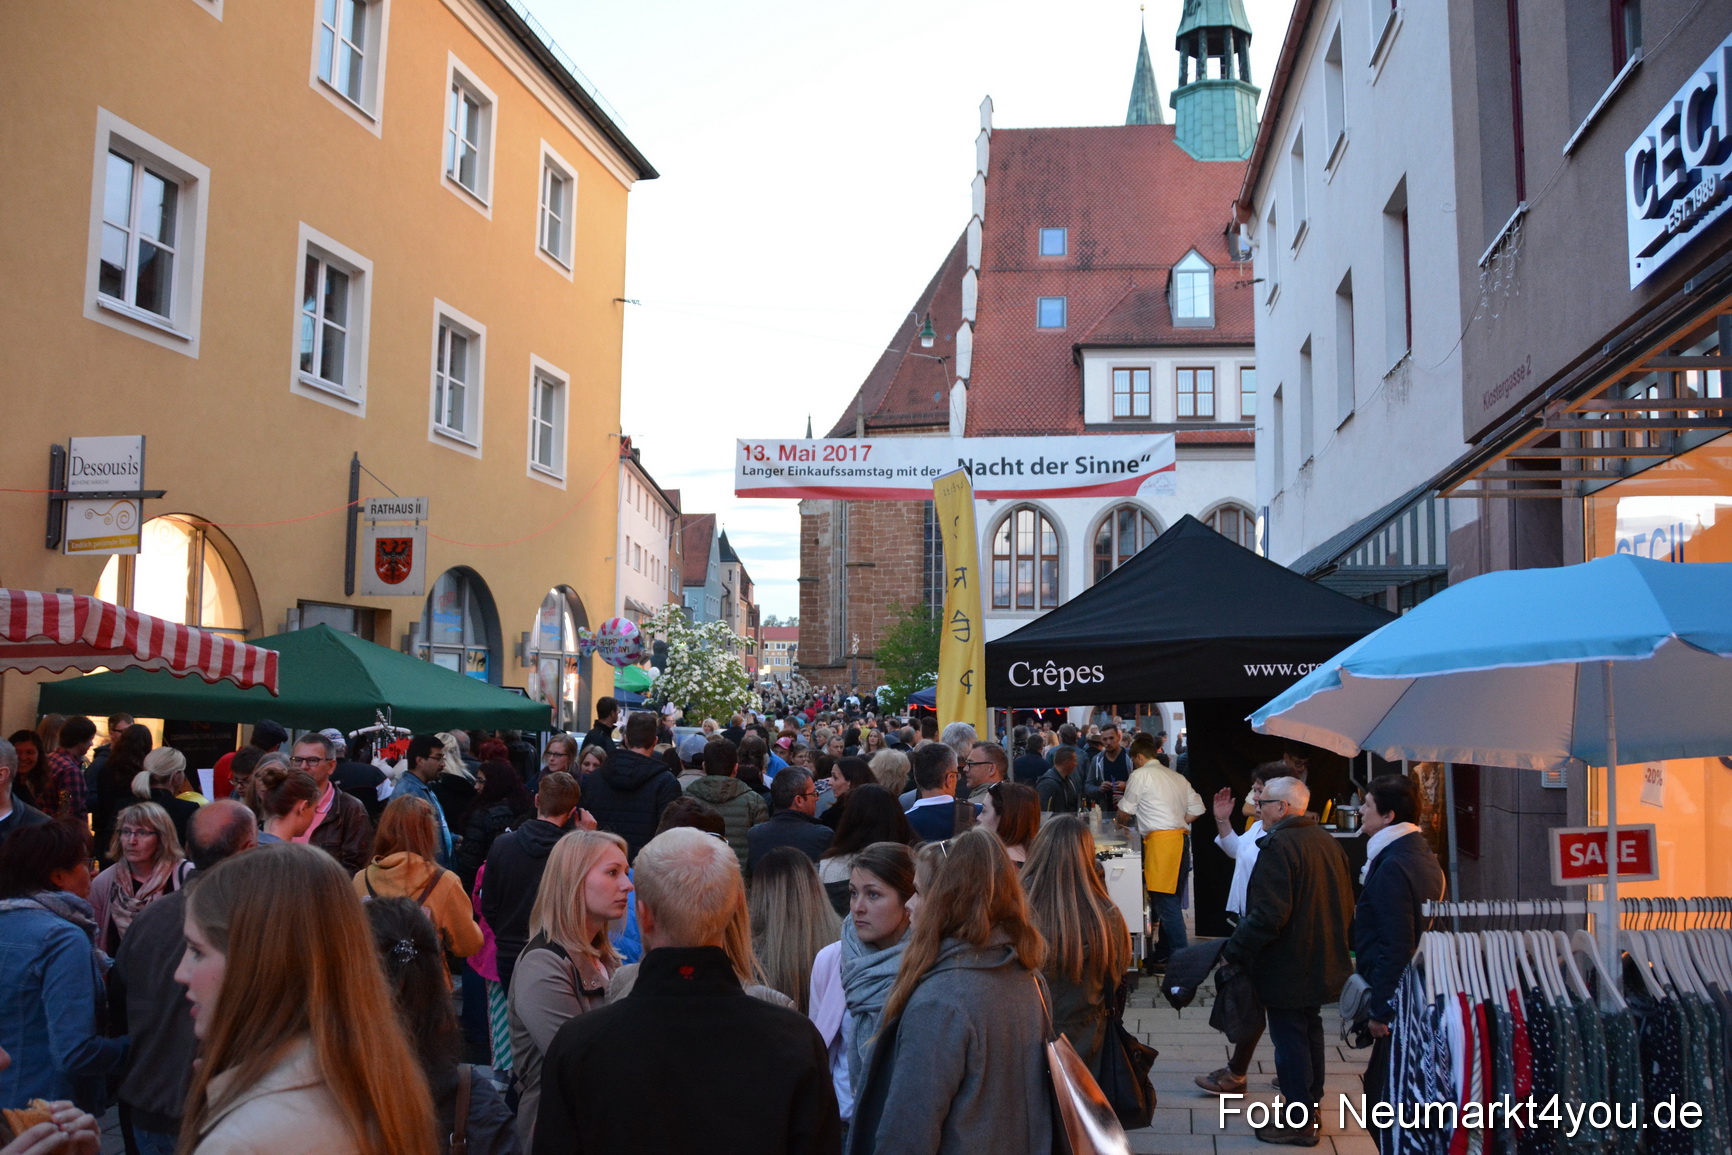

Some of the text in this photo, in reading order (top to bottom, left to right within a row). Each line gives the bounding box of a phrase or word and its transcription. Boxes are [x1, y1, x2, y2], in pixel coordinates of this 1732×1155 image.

[1667, 174, 1716, 235] EST. 1989
[1483, 353, 1532, 412] Klostergasse 2
[743, 444, 873, 462] 13. Mai 2017
[742, 465, 785, 478] Langer
[787, 465, 893, 479] Einkaufssamstag
[896, 466, 918, 477] mit
[920, 465, 942, 477] der
[1030, 456, 1069, 475] der
[370, 504, 414, 514] RATHAUS
[599, 637, 623, 646] HAPPY
[1007, 659, 1105, 692] Crêpes
[1644, 767, 1664, 787] -20%
